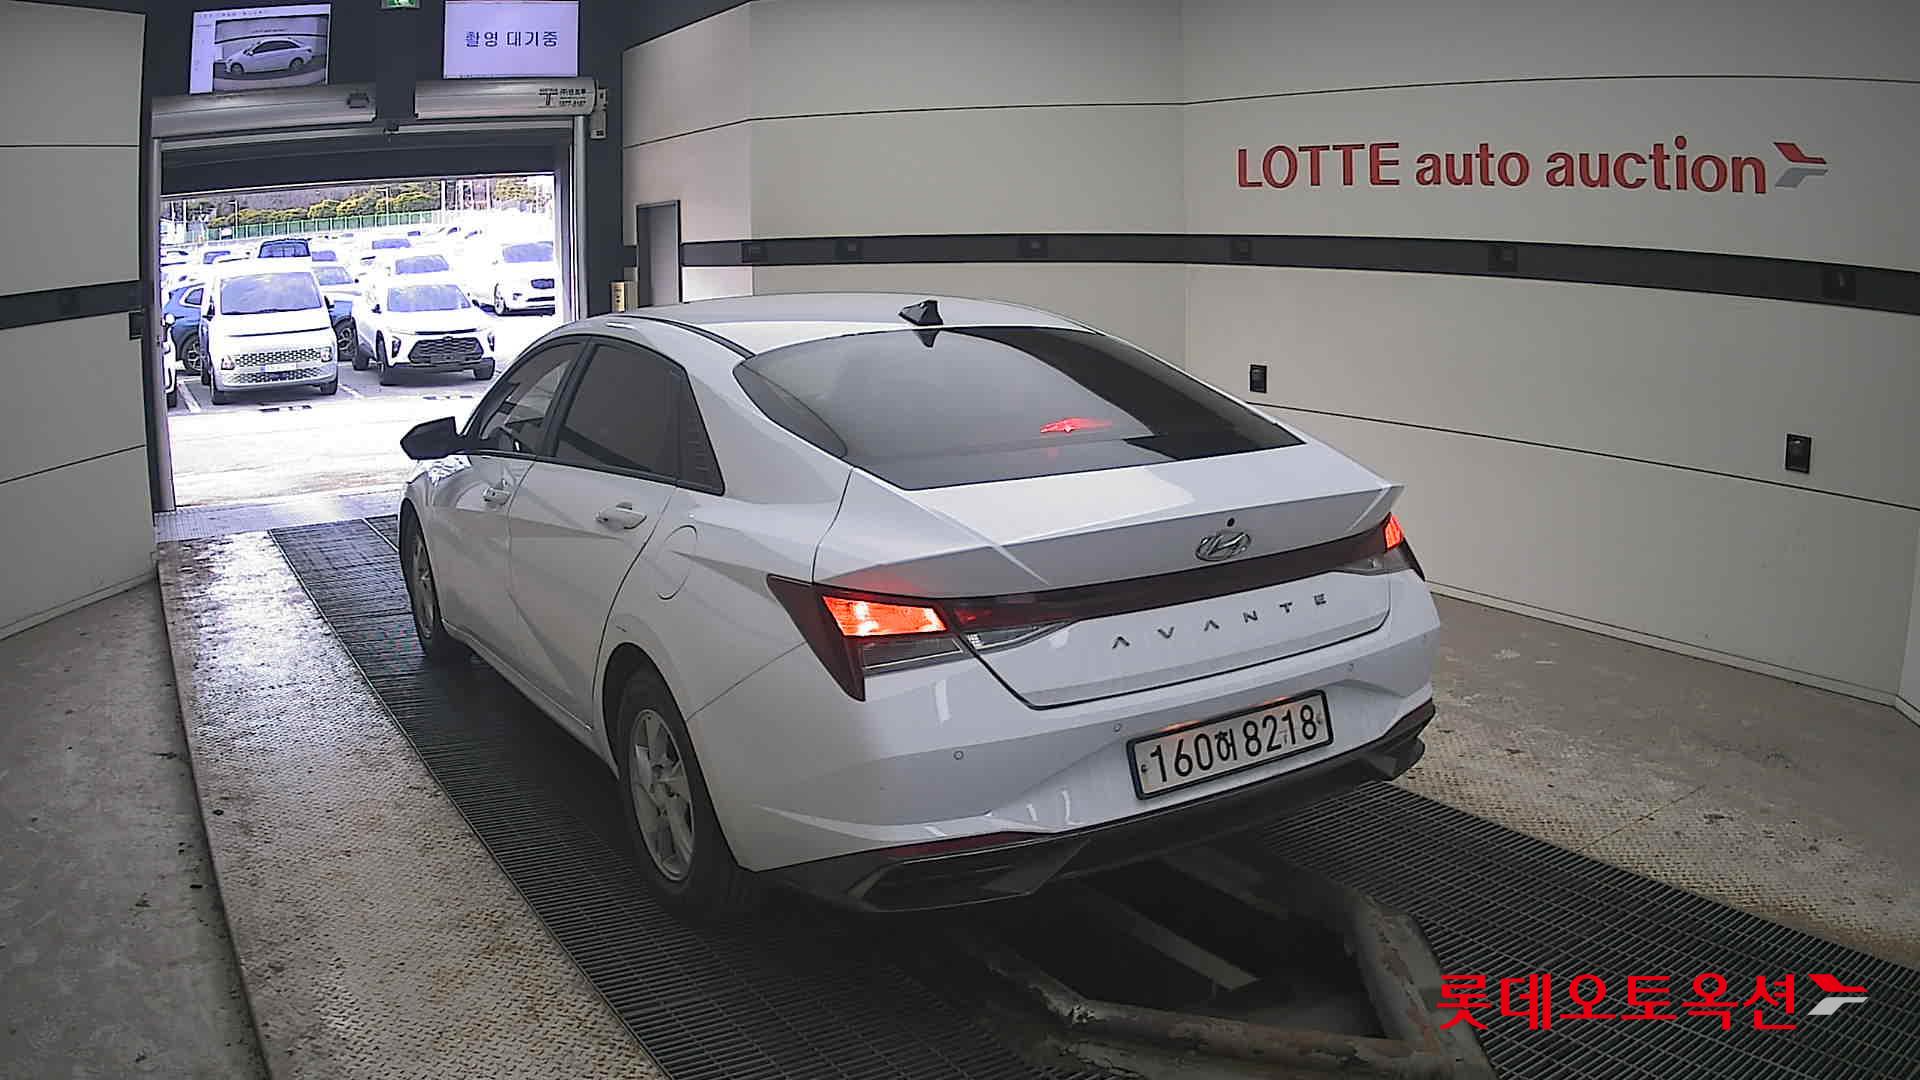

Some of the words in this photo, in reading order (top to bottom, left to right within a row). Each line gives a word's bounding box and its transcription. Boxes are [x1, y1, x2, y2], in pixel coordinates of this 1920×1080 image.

[506, 31, 558, 48] 대기중
[1236, 142, 1400, 188] LOTTE
[1415, 142, 1531, 187] auto
[1545, 136, 1767, 194] auction
[1112, 593, 1326, 650] AVANTE
[1150, 727, 1238, 782] 160허
[1242, 704, 1317, 757] 8218
